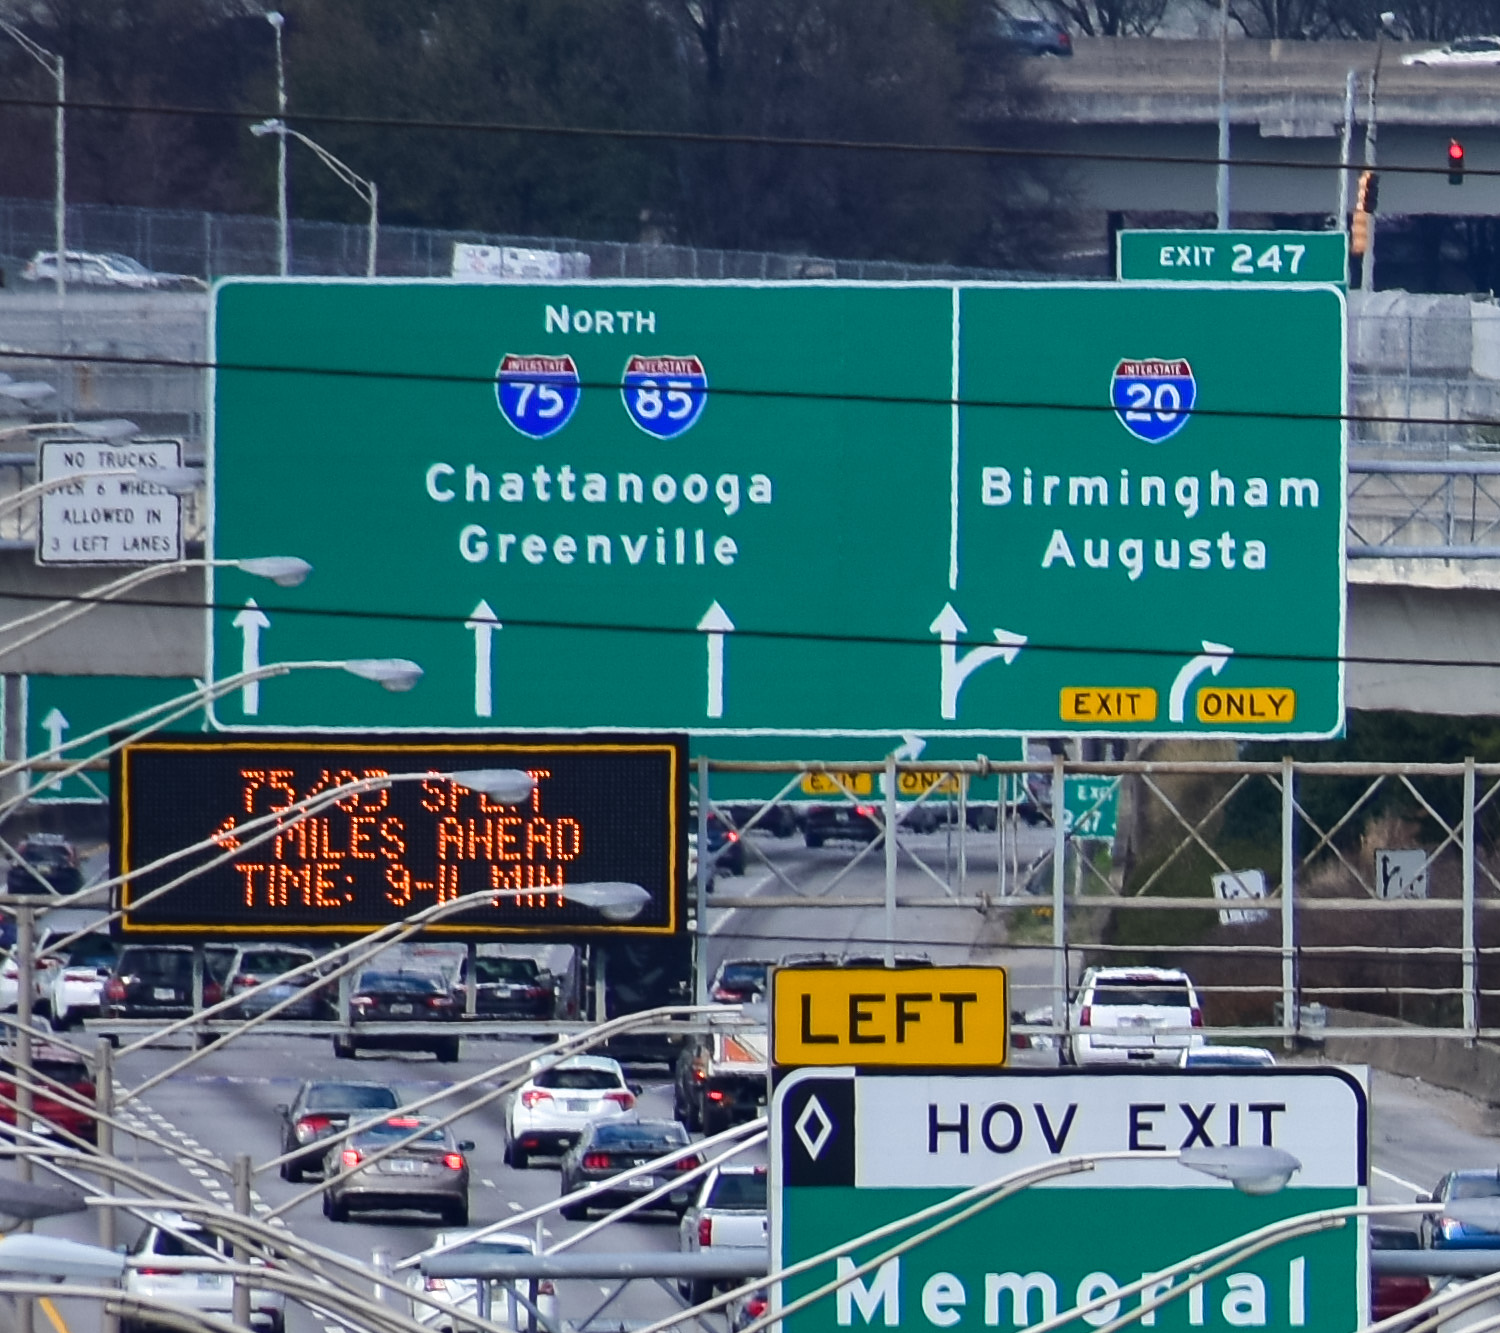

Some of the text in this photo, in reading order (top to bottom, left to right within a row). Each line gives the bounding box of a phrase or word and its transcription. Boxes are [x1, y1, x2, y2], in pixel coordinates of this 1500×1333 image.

[1160, 243, 1306, 275] EXIT 247
[545, 303, 657, 334] NORTH
[508, 359, 567, 373] INTERSTATE
[634, 360, 696, 374] INTERSTATE
[1124, 364, 1182, 376] INTERSTATE
[508, 381, 566, 418] 75
[634, 380, 695, 420] 85
[1125, 383, 1182, 422] 20
[63, 451, 159, 469] NO TRUCKS
[96, 480, 106, 496] 6
[425, 462, 774, 516] Chattanooga
[981, 466, 1320, 520] Birmingham
[63, 508, 162, 525] ALLOWED IN
[73, 536, 110, 551] LEFT
[122, 536, 171, 552] LANES
[458, 523, 740, 566] Greenville
[1042, 526, 1268, 580] Augusta
[1074, 693, 1288, 719] EXIT ONLY
[275, 816, 407, 861] MILES
[437, 816, 582, 861] AHEAD
[235, 862, 354, 907] TIME:
[490, 863, 564, 909] MIN
[798, 992, 978, 1045] LEFT
[927, 1102, 1288, 1154] HOV EXIT
[835, 1255, 1308, 1328] Memorial
